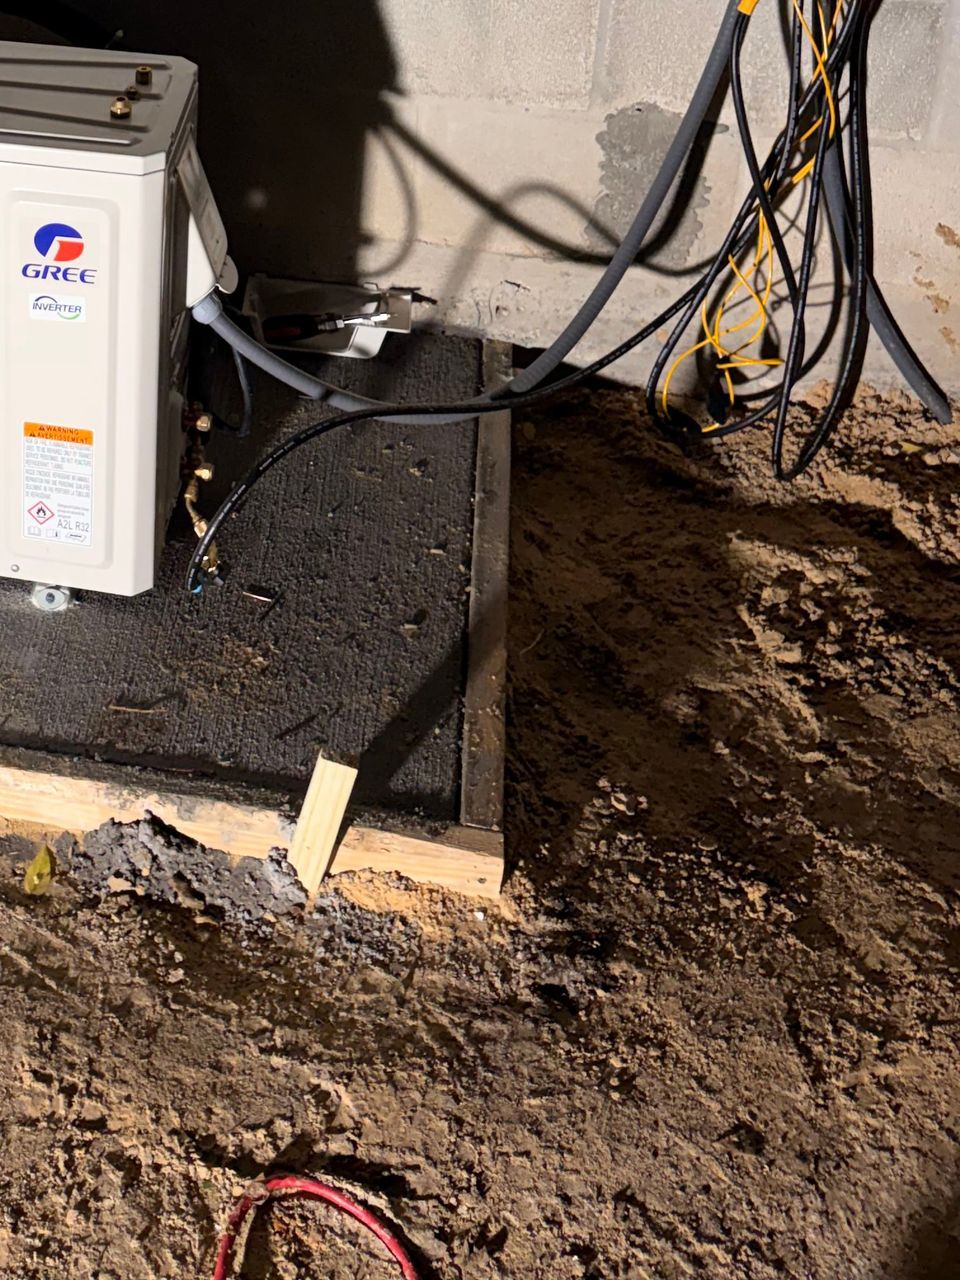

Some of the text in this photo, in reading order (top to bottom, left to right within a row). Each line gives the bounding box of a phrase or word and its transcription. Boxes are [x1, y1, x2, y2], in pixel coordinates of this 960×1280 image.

[21, 263, 98, 285] GREE
[32, 302, 82, 313] INVERTER
[46, 424, 79, 436] WARNING
[37, 431, 89, 445] AVERTISSEMENT
[57, 519, 90, 533] A2L R32
